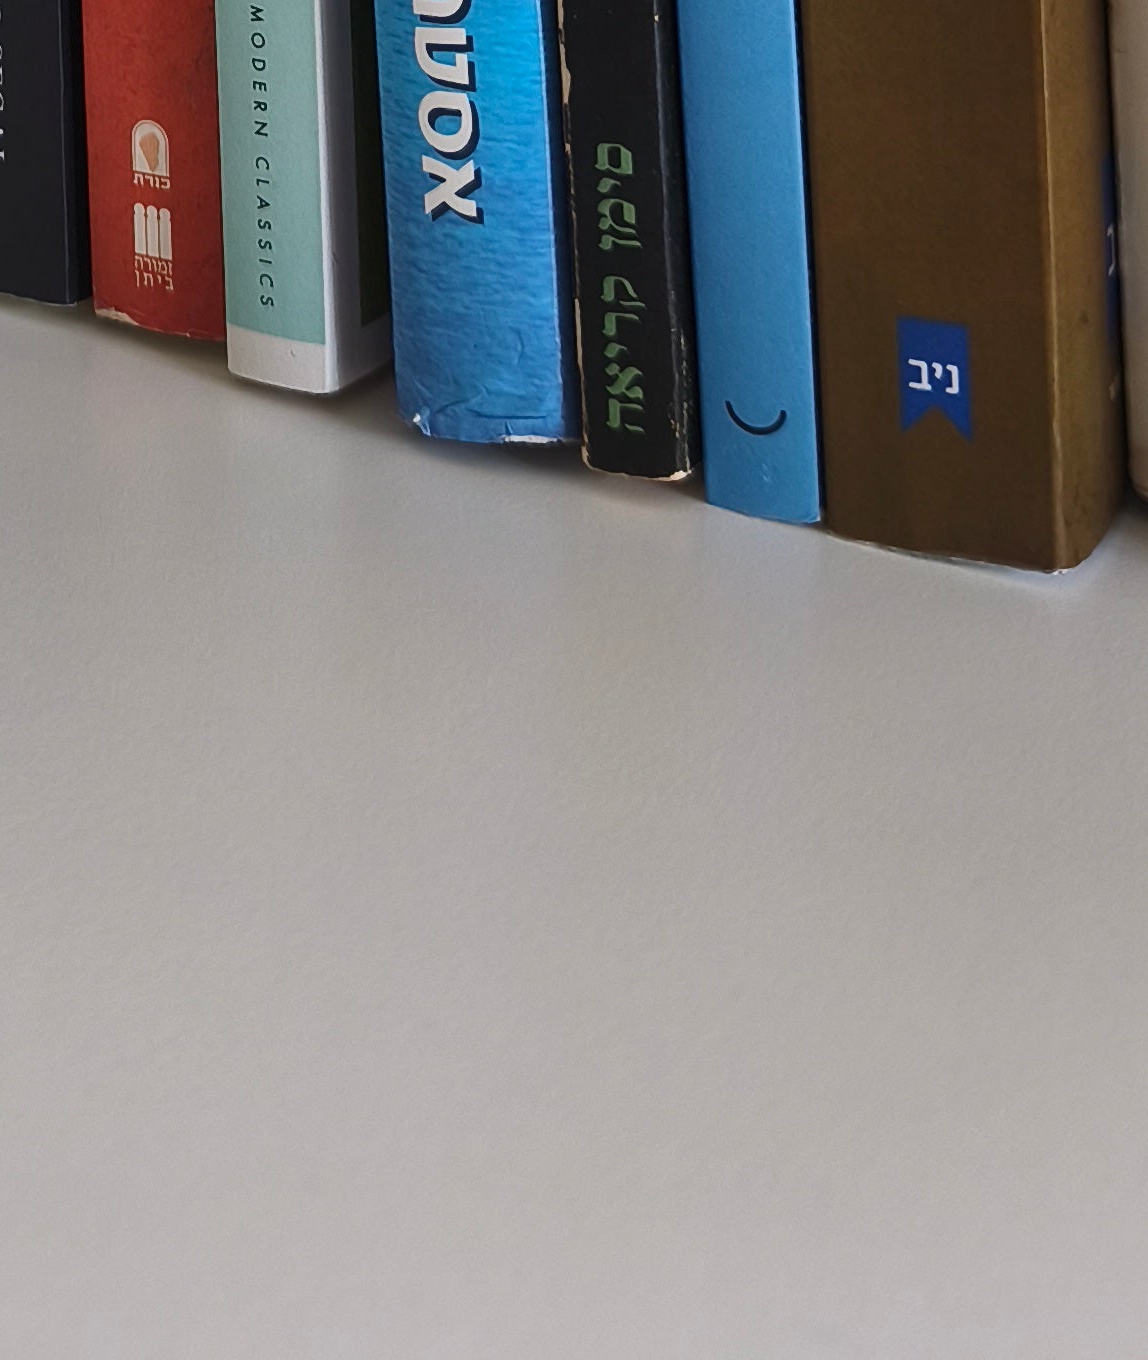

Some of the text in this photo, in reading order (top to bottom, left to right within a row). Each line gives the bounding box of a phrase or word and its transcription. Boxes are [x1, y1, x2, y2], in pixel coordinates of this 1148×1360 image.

[248, 3, 276, 309] MODERN CLASSICS
[134, 254, 173, 277] זמורה
[134, 269, 174, 291] ביתן
[595, 141, 647, 434] סימן קריאה
[907, 357, 961, 395] ניב
